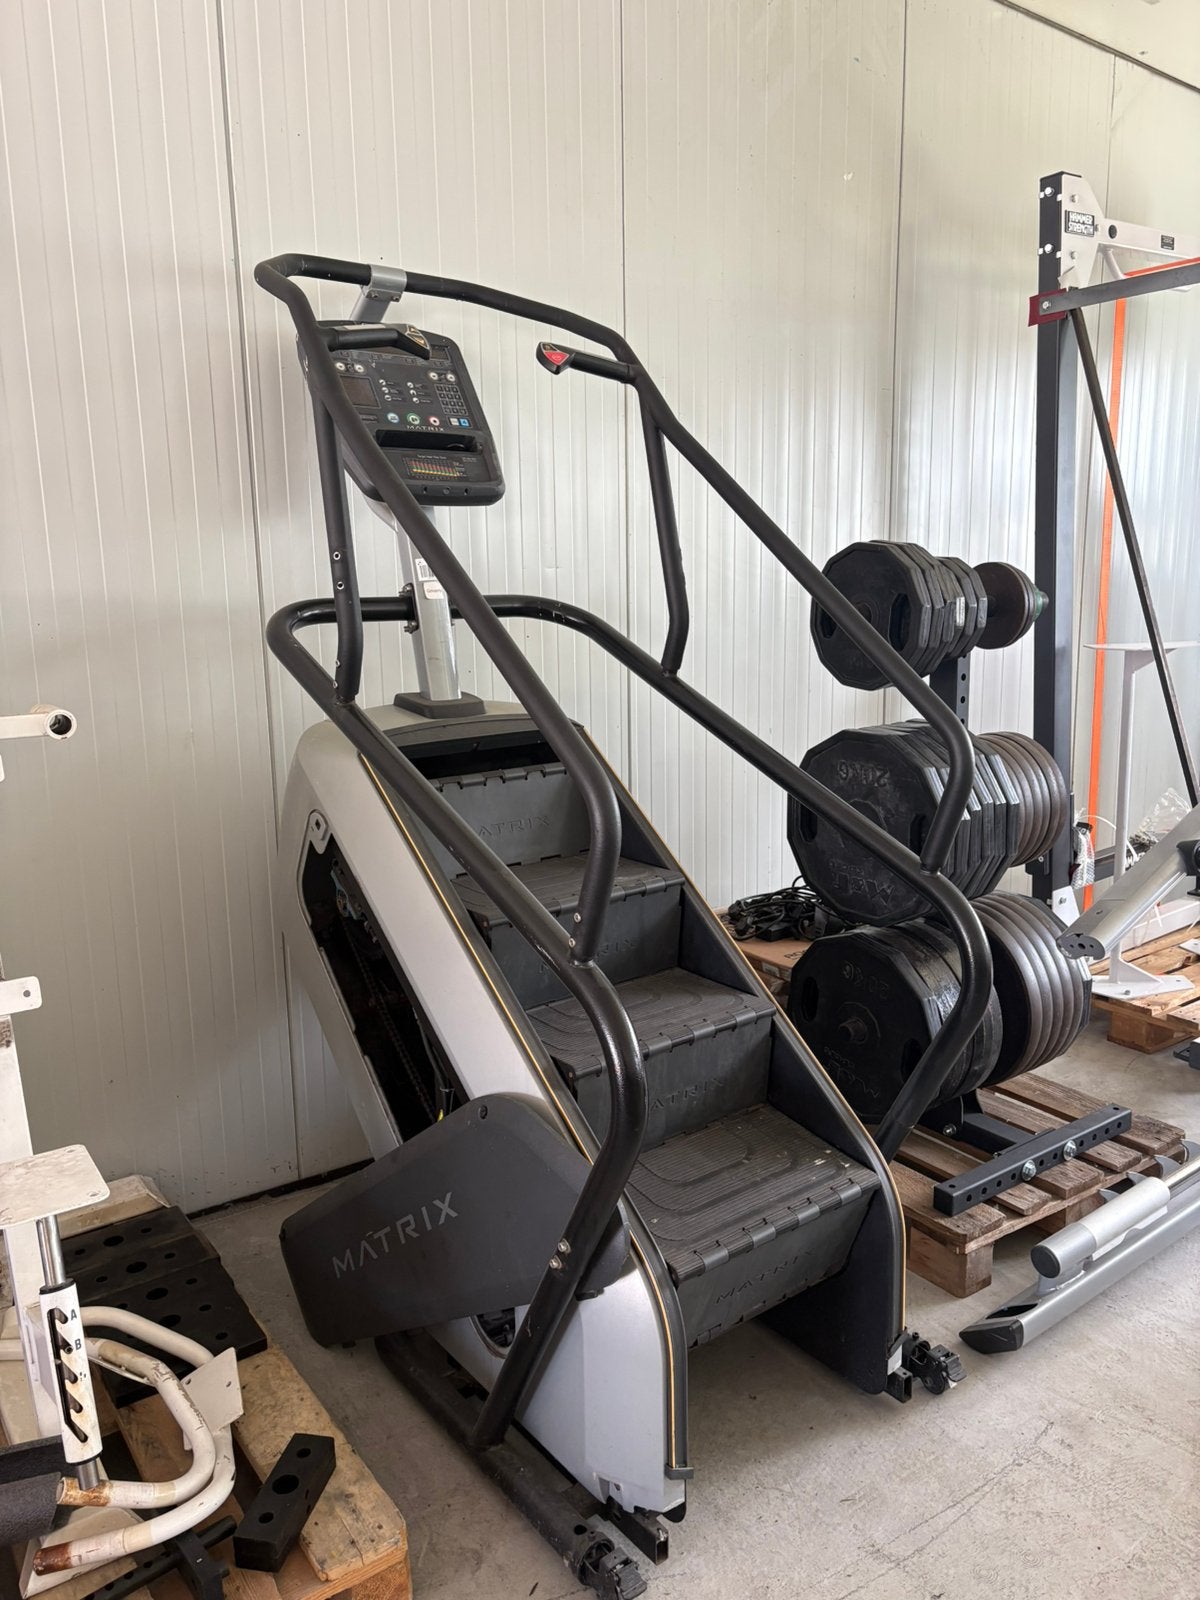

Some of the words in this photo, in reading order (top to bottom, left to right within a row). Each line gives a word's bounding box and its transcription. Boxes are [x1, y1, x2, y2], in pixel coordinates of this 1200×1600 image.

[1070, 211, 1093, 225] HAMMER
[477, 814, 550, 838] ATRIX
[650, 1077, 725, 1112] ATRIX
[332, 1191, 459, 1279] MATRIX
[70, 1308, 78, 1321] A
[74, 1338, 82, 1351] B
